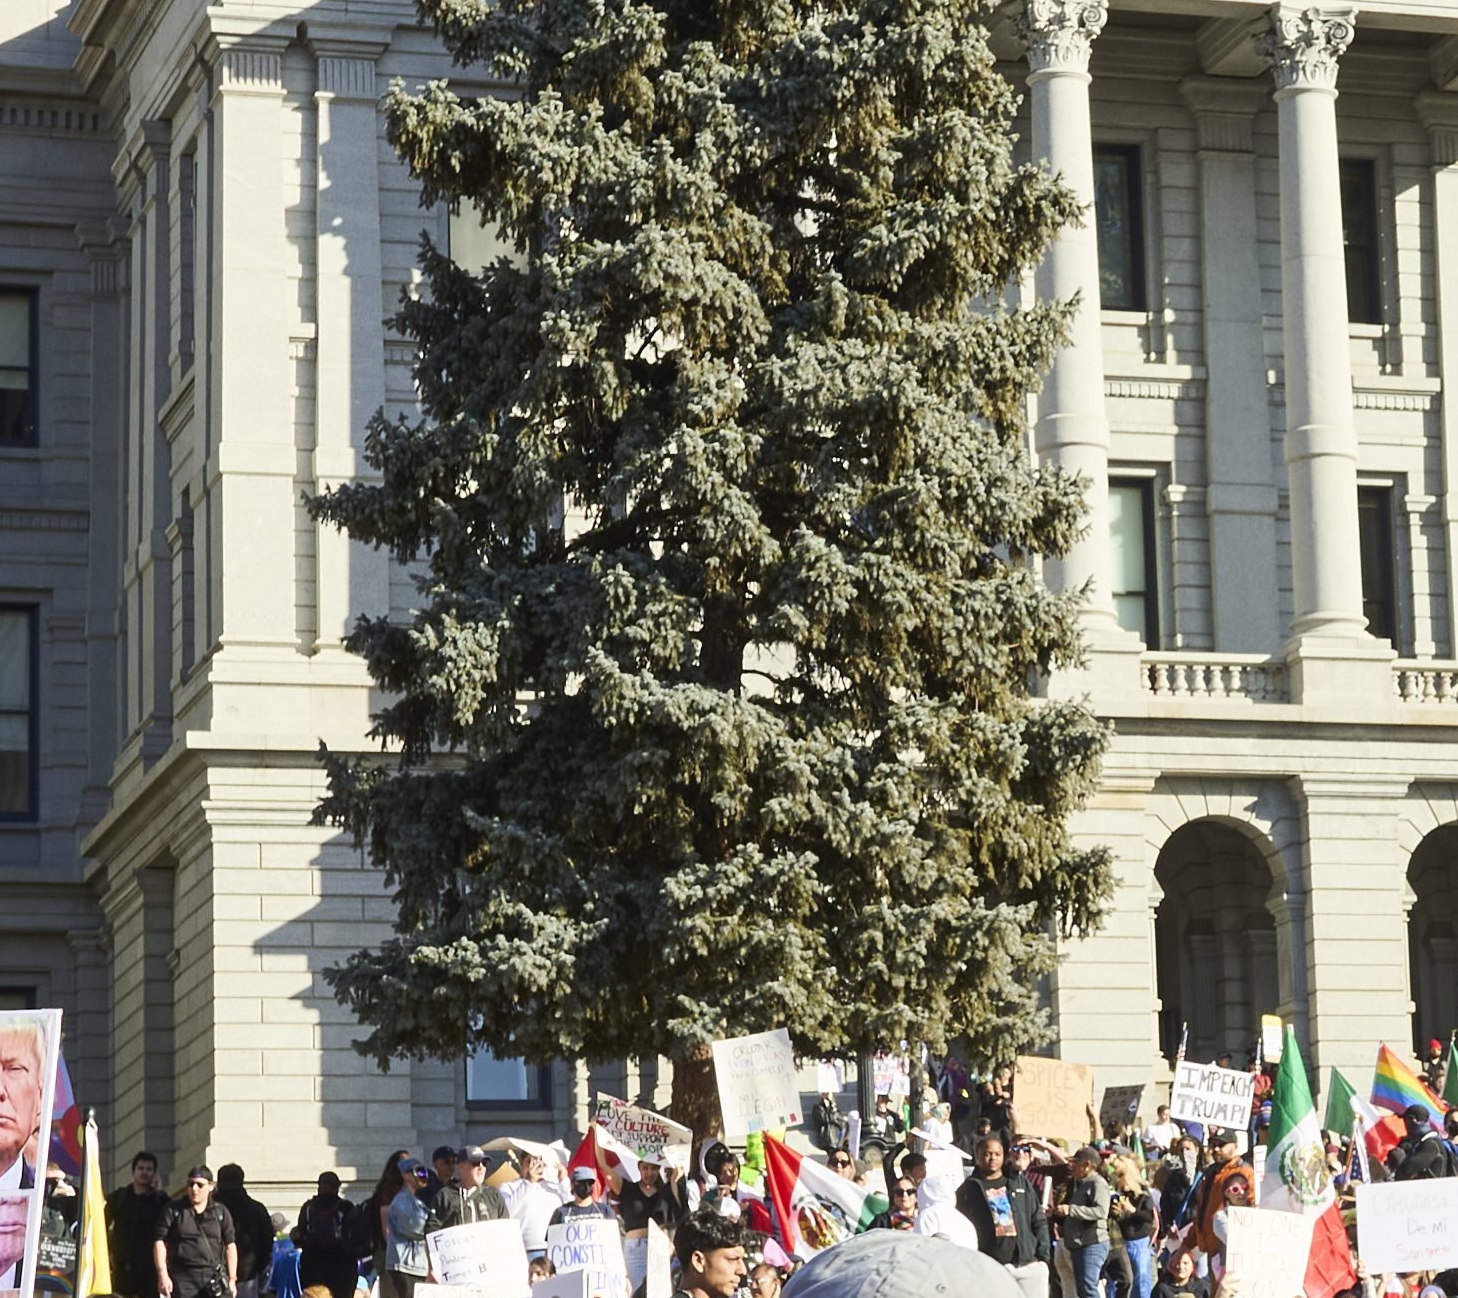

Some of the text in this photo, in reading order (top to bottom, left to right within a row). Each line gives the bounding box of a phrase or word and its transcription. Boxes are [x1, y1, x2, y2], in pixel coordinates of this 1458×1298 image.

[1023, 1062, 1075, 1090] SPICE
[1180, 1066, 1253, 1098] IMPEACH
[1047, 1091, 1068, 1107] IS
[1177, 1093, 1246, 1124] TRUMP!
[615, 1120, 669, 1138] CULTURE
[1019, 1109, 1083, 1131] GOOD
[1233, 1210, 1253, 1228] NO
[1407, 1218, 1448, 1235] De Mi
